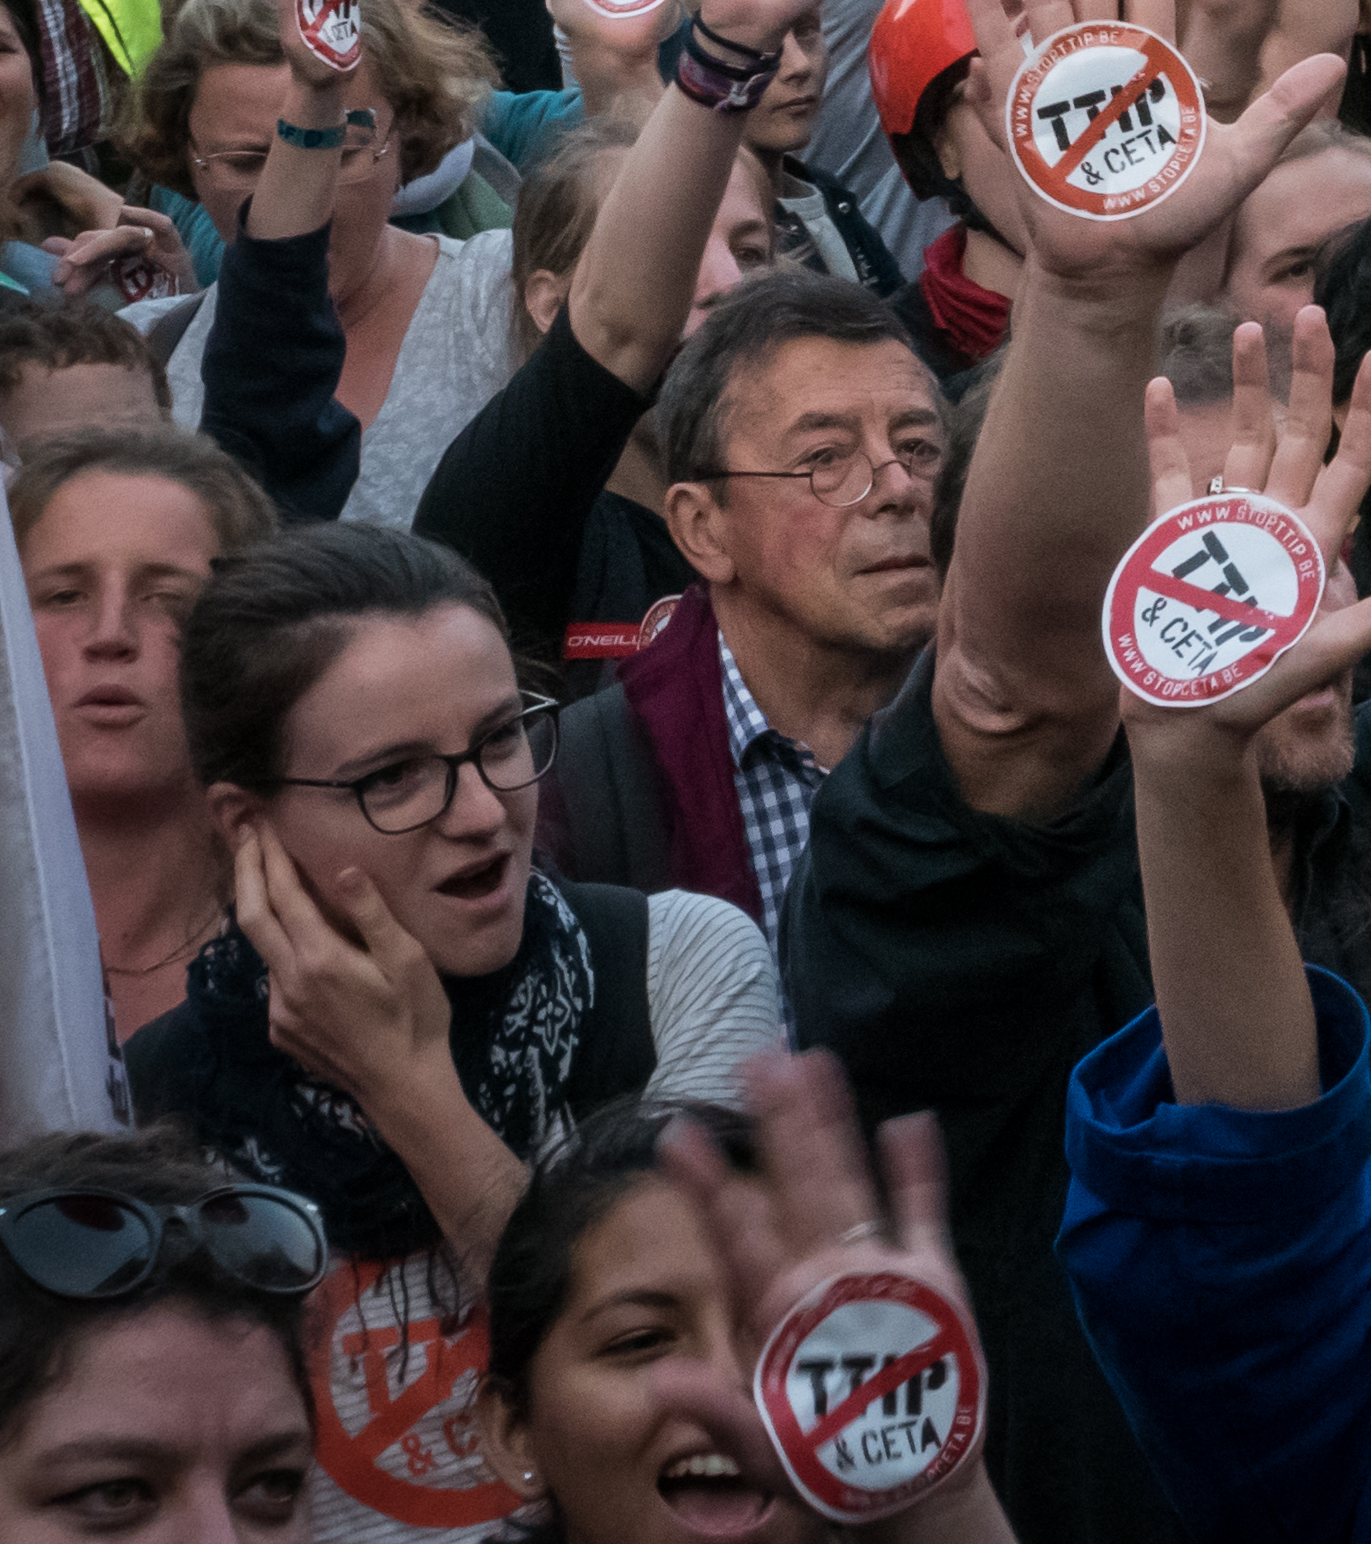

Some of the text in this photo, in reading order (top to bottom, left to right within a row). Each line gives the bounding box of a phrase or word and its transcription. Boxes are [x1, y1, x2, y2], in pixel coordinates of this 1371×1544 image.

[1037, 78, 1166, 152] TTIP
[1081, 124, 1177, 186] & CETA
[1172, 530, 1270, 646] TTIP
[1141, 596, 1218, 677] & CETA
[796, 1352, 948, 1419] TTIP
[860, 1416, 943, 1468] CETA
